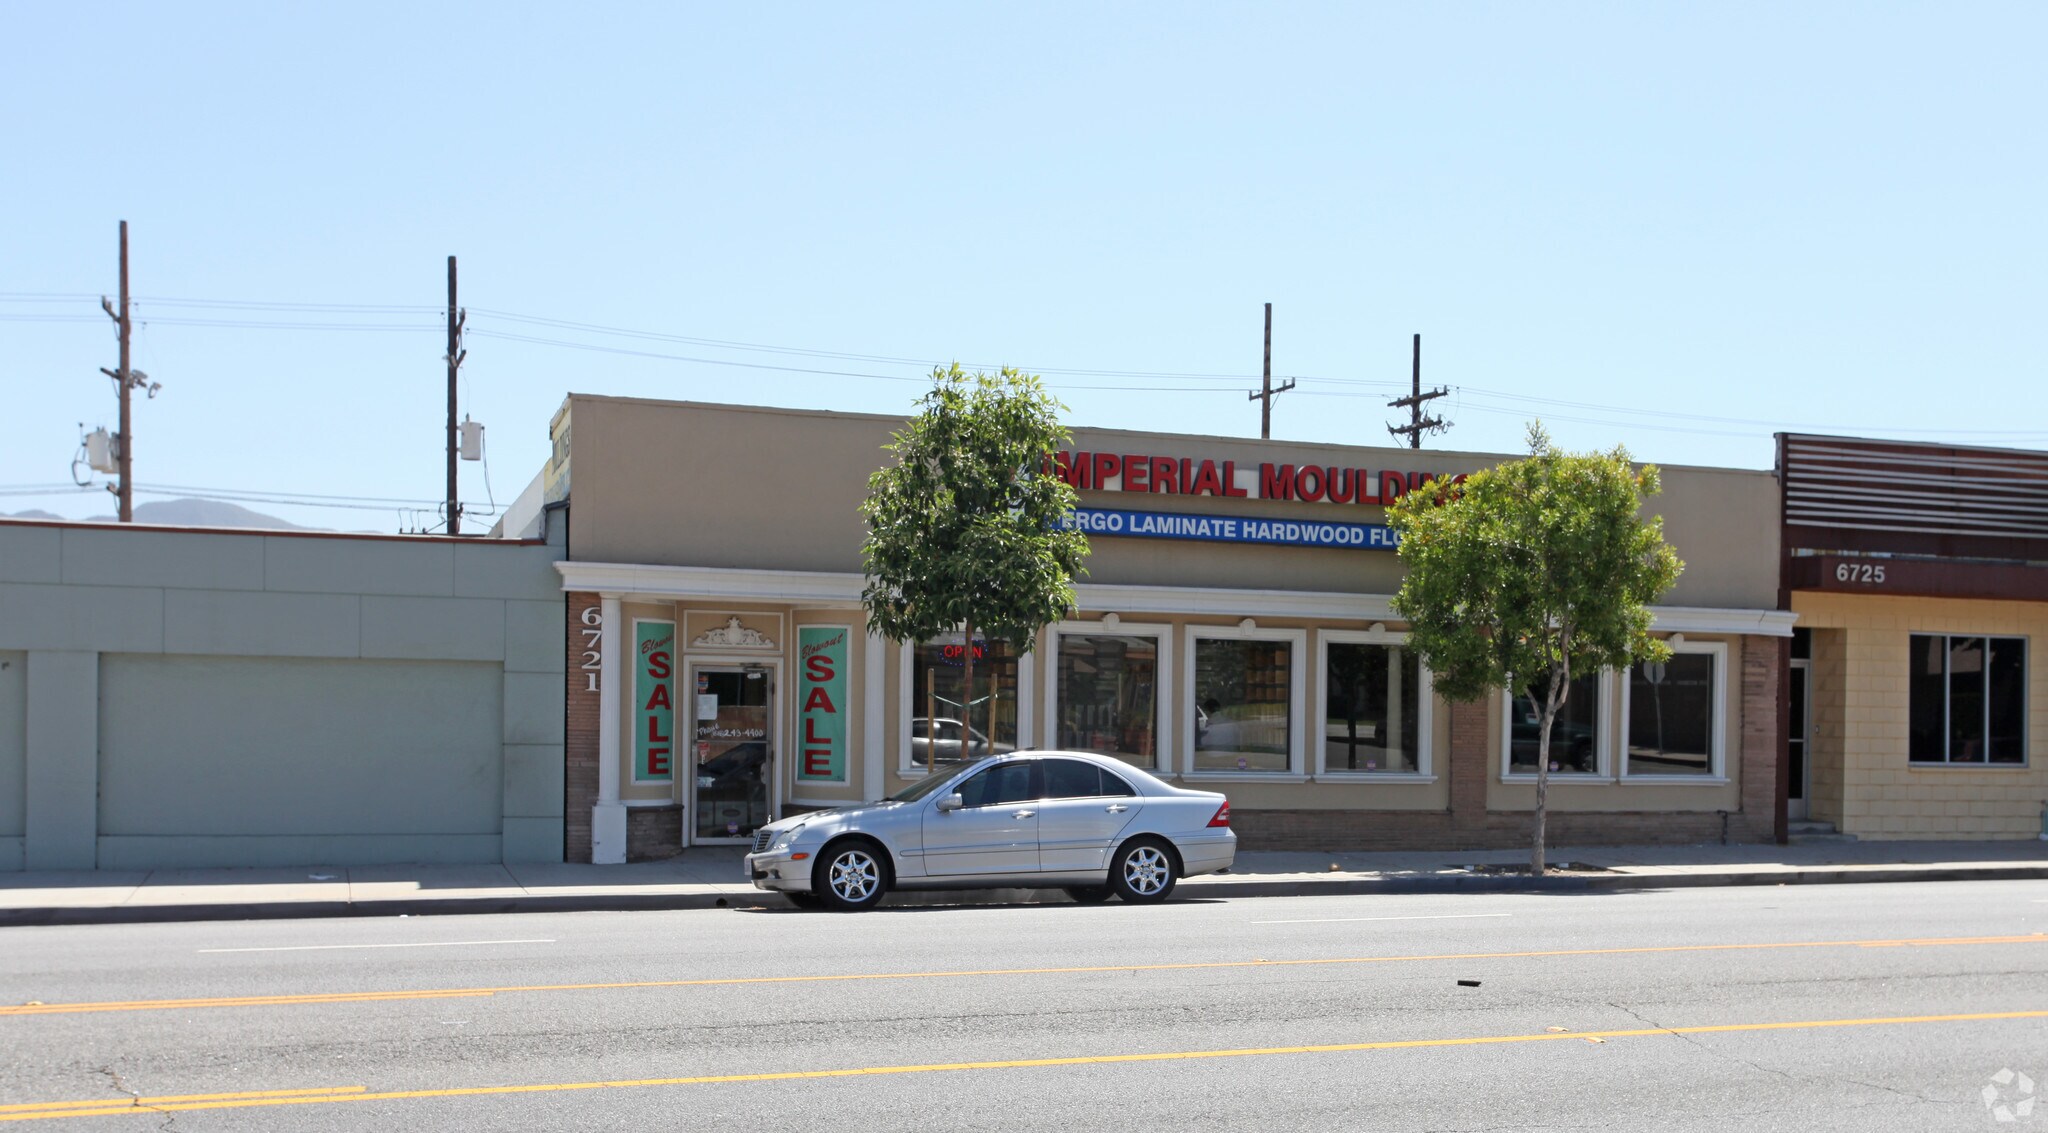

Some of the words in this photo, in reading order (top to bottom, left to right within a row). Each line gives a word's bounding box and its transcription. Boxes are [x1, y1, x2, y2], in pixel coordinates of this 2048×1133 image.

[1259, 463, 1468, 507] MOULDI
[1050, 511, 1123, 531] ERGO
[1130, 515, 1236, 537] LAMINATE
[1243, 522, 1364, 544] HARDWOOD
[1836, 563, 1885, 583] 6725
[581, 606, 602, 691] 6721
[645, 651, 671, 775] SALE
[803, 655, 836, 776] SALE
